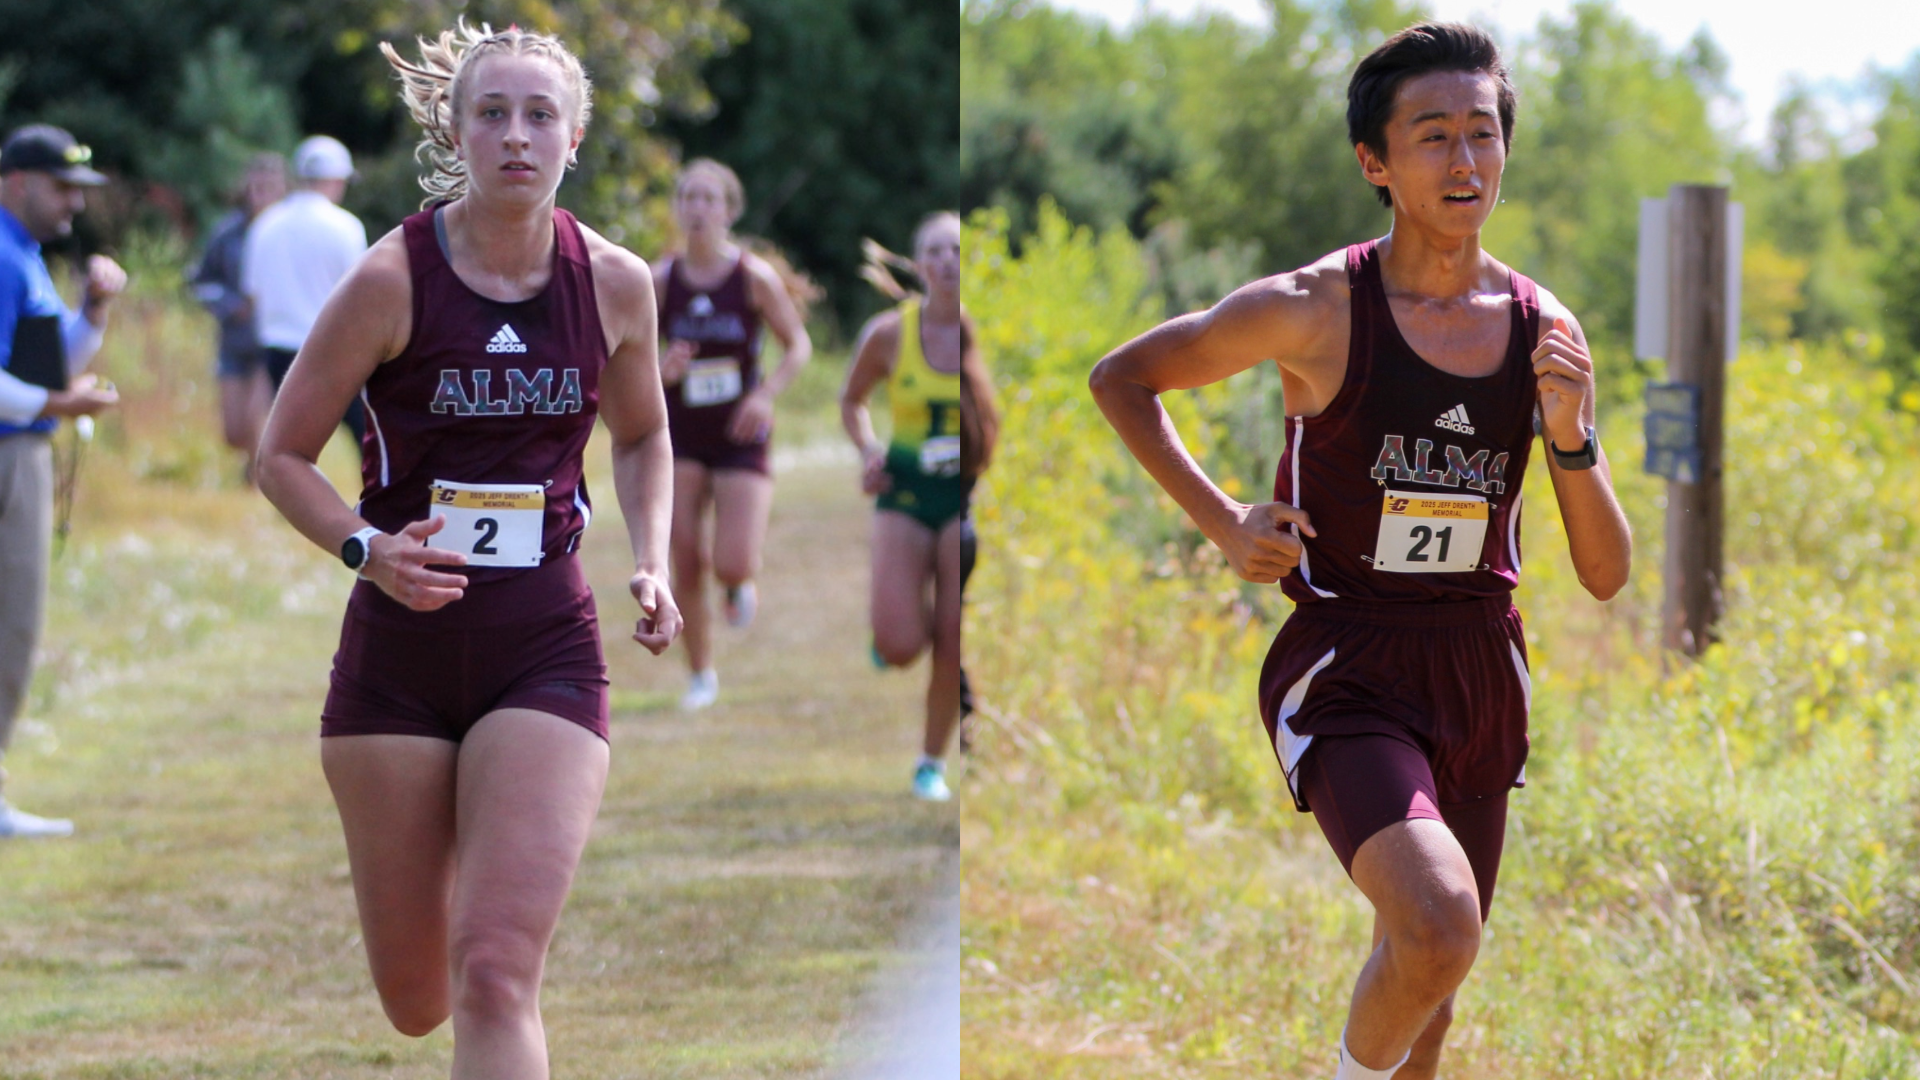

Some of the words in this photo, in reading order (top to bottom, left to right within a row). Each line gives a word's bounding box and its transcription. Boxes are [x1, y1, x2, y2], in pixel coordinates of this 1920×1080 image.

[486, 341, 527, 353] adidas
[430, 369, 582, 415] ALMA
[1435, 418, 1475, 435] adidas
[1371, 434, 1509, 494] ALMA
[489, 492, 503, 500] JEFF
[1432, 509, 1462, 517] MEMORIAL
[1437, 501, 1451, 509] JEFF
[1452, 501, 1476, 510] DRENTH
[472, 517, 498, 555] 2
[1405, 525, 1452, 562] 21
